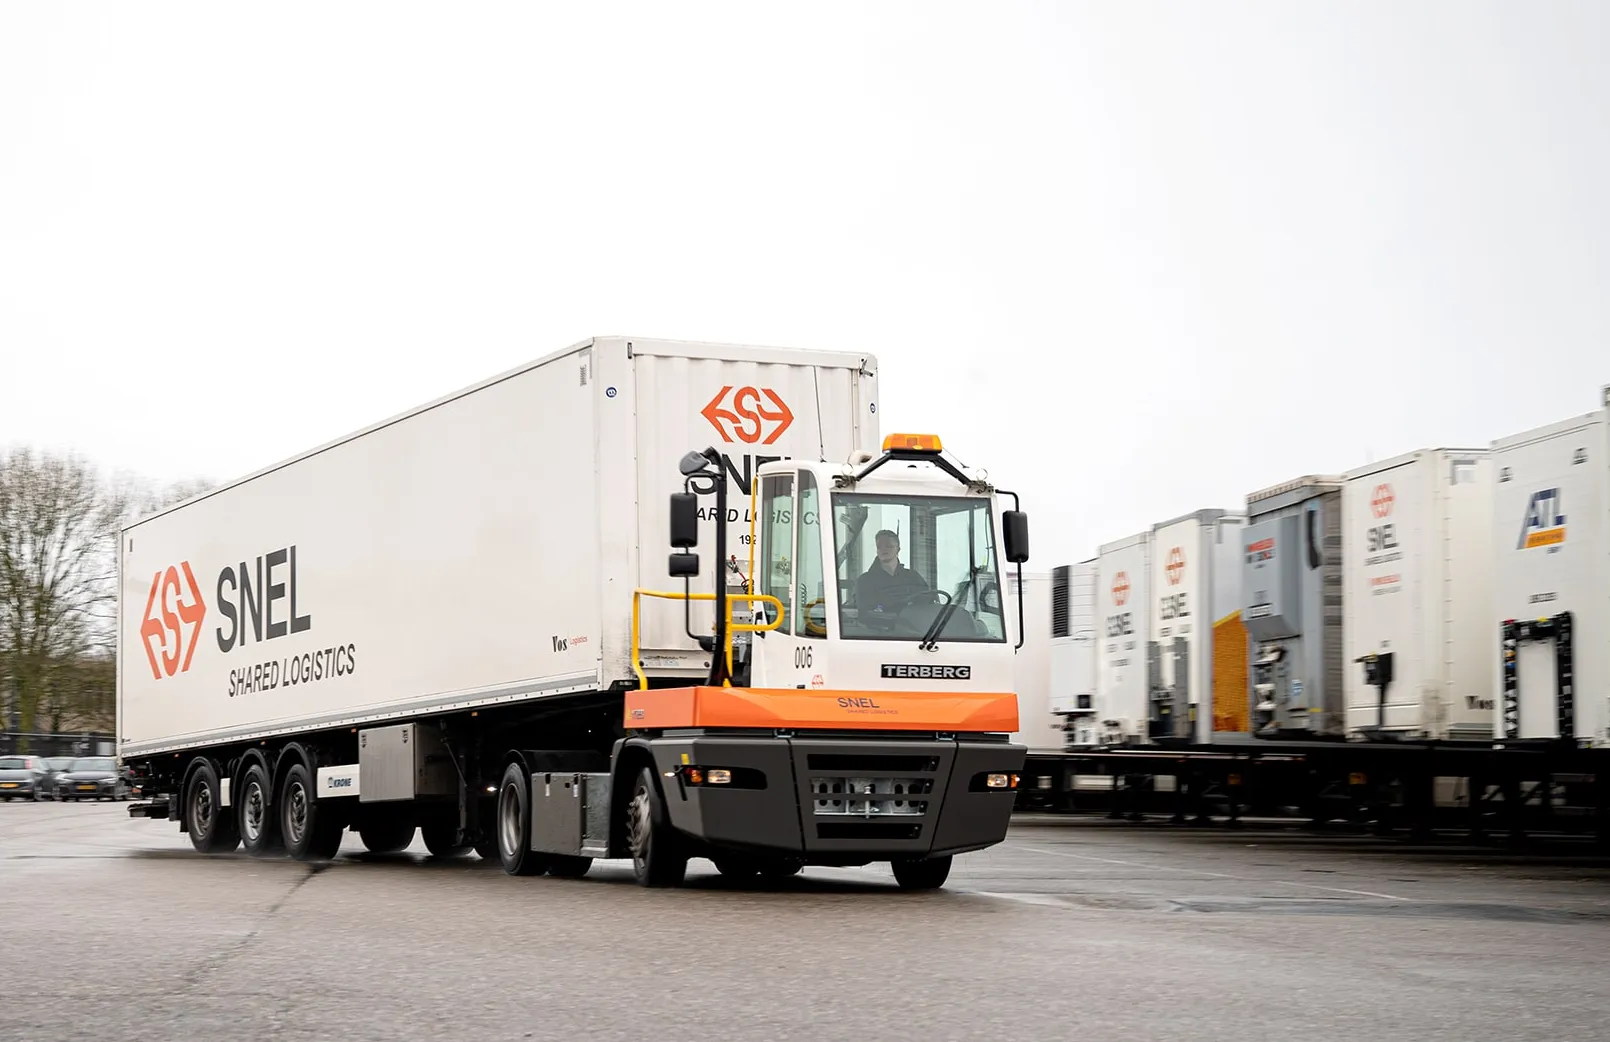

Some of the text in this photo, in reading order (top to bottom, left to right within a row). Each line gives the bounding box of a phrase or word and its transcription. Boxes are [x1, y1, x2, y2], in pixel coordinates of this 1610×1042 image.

[216, 545, 311, 653] SNEL
[552, 635, 568, 652] Vos
[794, 646, 813, 669] 006
[228, 643, 356, 698] SHARED LOGISTICS
[883, 665, 970, 678] TERBERG
[837, 697, 880, 708] SNEL
[334, 777, 352, 787] KRONE
